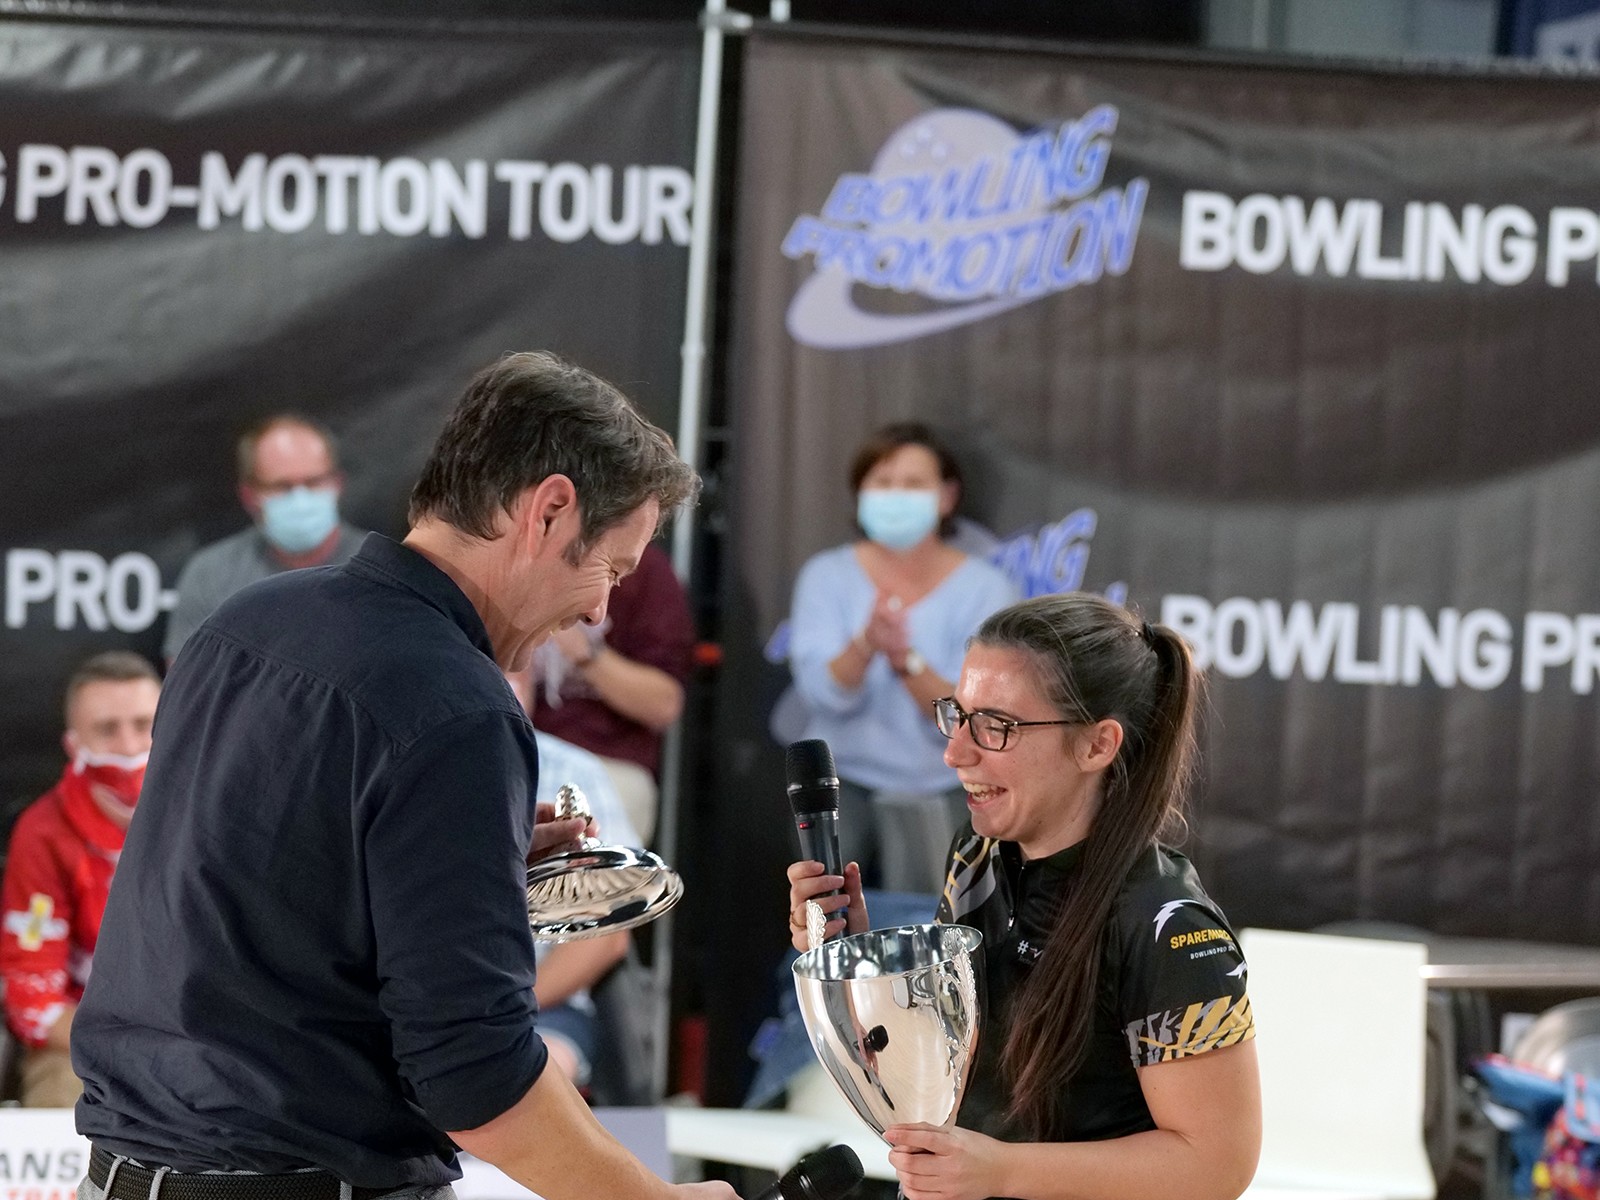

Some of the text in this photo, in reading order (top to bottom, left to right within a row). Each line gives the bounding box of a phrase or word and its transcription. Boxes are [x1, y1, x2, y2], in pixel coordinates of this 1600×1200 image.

[15, 144, 489, 239] PRO-MOTION
[494, 159, 692, 247] TOUR
[820, 103, 1119, 225] BOWLING
[781, 176, 1150, 300] PROMOTION
[1178, 190, 1600, 288] BOWLING P
[1158, 594, 1513, 692] BOWLING
[1190, 948, 1217, 960] BOWLING
